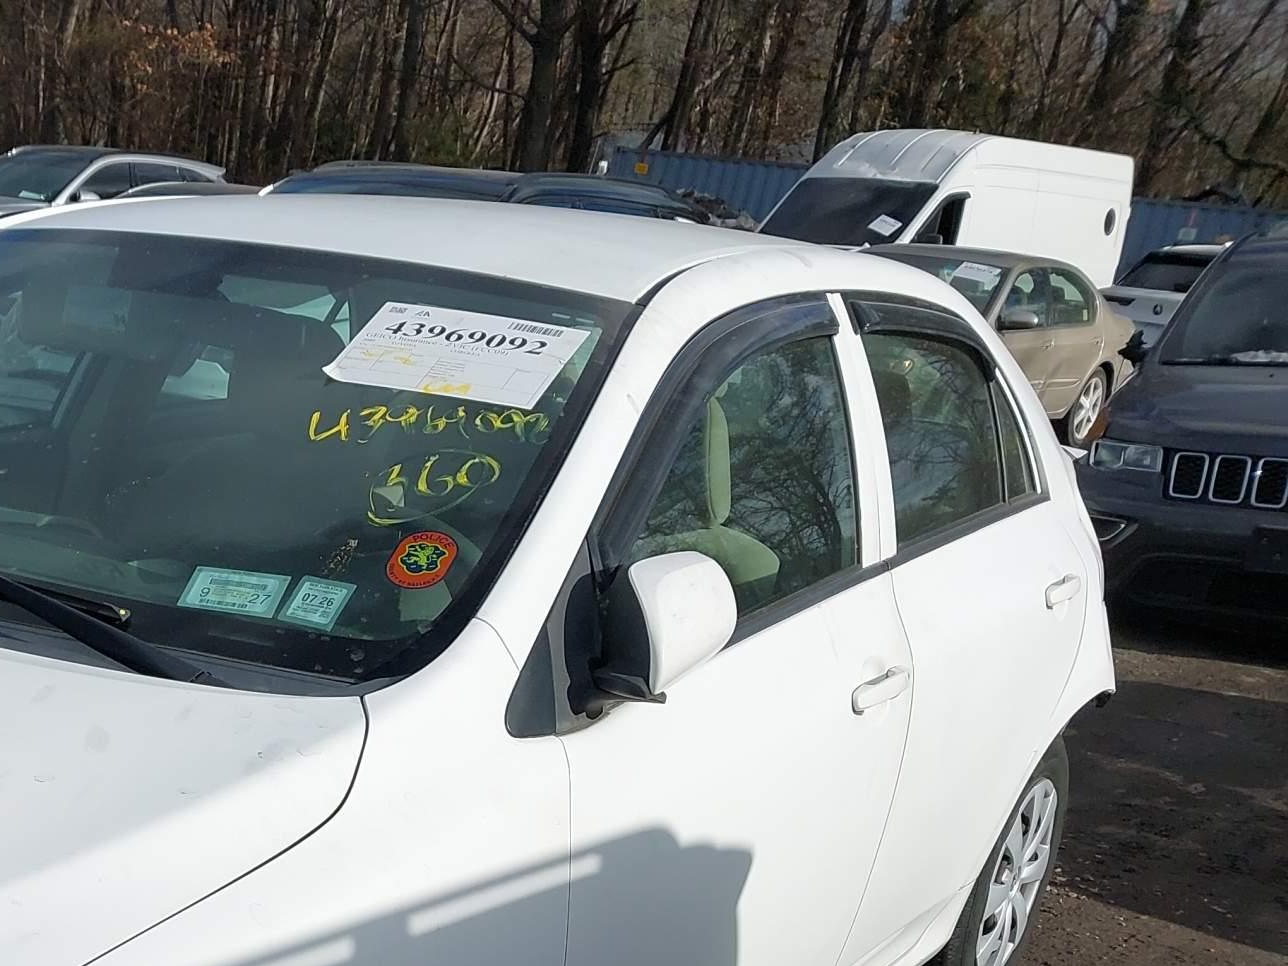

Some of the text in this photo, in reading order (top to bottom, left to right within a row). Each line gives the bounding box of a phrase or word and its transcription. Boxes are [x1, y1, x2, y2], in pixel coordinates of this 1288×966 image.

[384, 320, 549, 356] 43969092
[411, 533, 455, 549] POLICE
[199, 586, 211, 598] 9
[247, 593, 273, 605] 27
